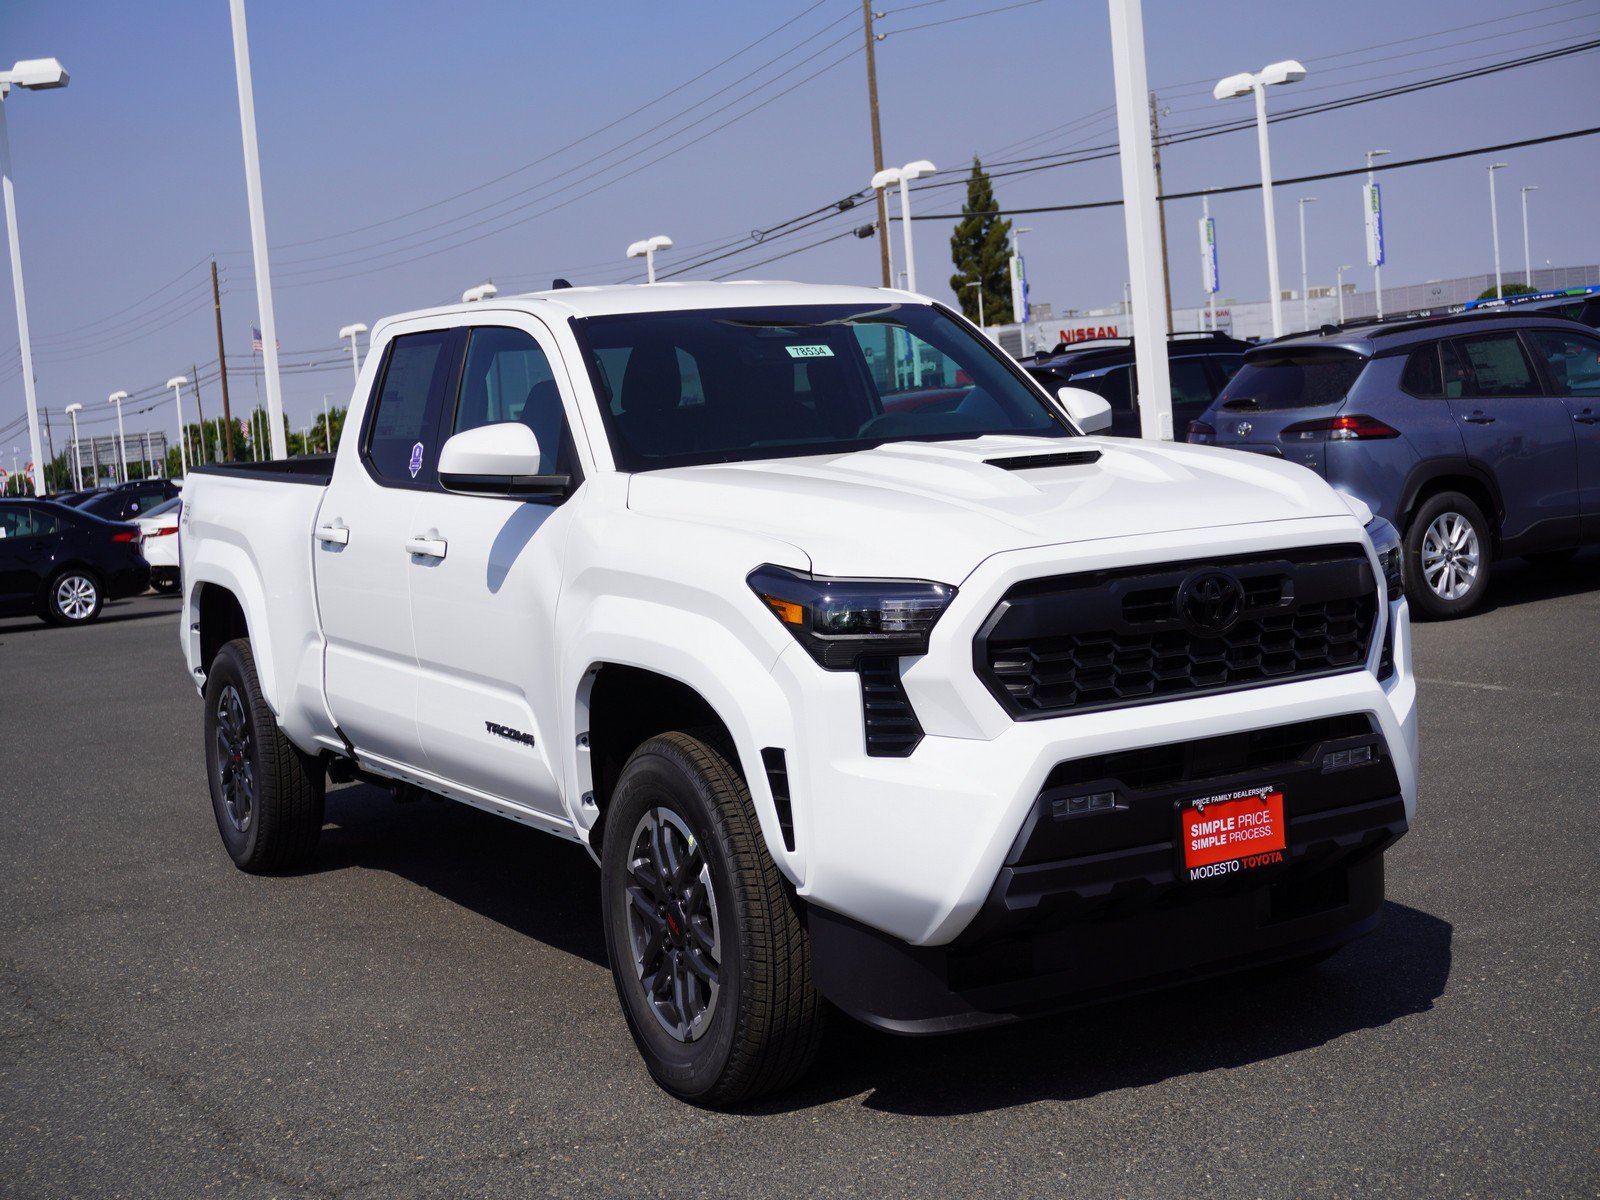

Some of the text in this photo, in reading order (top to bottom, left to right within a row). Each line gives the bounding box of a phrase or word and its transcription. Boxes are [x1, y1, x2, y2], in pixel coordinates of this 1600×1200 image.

[1059, 325, 1118, 343] NISSAN
[792, 346, 827, 356] 78534
[485, 720, 535, 748] TACOMA
[1192, 786, 1274, 807] PRICE FAMILY DEALERSHIPS
[1191, 810, 1273, 838] SIMPLE PRICE.
[1191, 825, 1274, 851] SIMPLE PROCESS.
[1190, 852, 1283, 881] MODESTO TOYOTA
